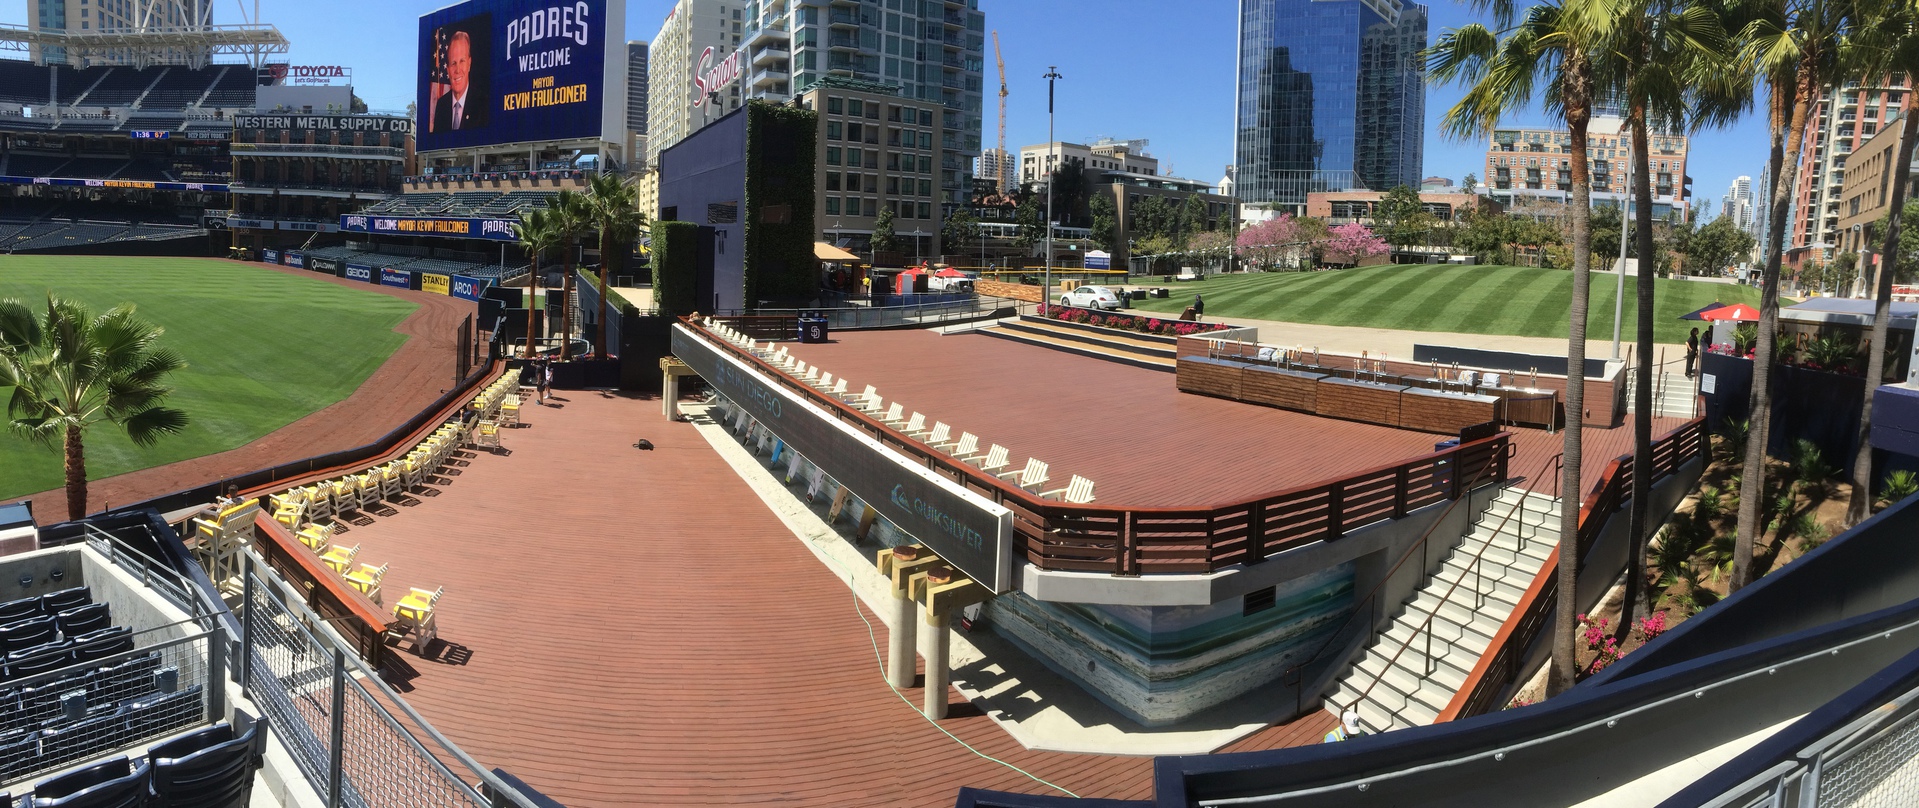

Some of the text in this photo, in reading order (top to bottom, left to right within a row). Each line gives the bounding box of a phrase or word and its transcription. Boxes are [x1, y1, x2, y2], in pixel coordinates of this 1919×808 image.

[507, 1, 589, 61] PADRES
[518, 47, 571, 73] WELCOME
[292, 65, 344, 77] TOYOTA
[532, 75, 555, 89] MAYOR
[694, 46, 743, 116] Sycuan
[503, 83, 587, 111] KEVIN FAULCONER
[234, 116, 411, 133] WESTERN METAL SUPPLY CO.
[346, 217, 367, 230] PADRES
[374, 219, 469, 233] WELCOME MAYOR KEVIN FAULCONER
[482, 220, 514, 238] PADRES
[290, 256, 302, 265] bank
[312, 259, 336, 270] QUALCOMM
[347, 267, 370, 279] GEICO
[382, 274, 405, 284] Southwest
[422, 275, 448, 287] STANLEY
[454, 281, 472, 295] ARCO
[726, 367, 745, 392] SUN
[747, 380, 782, 418] DIEGO
[914, 498, 983, 552] QUIKSILVER
